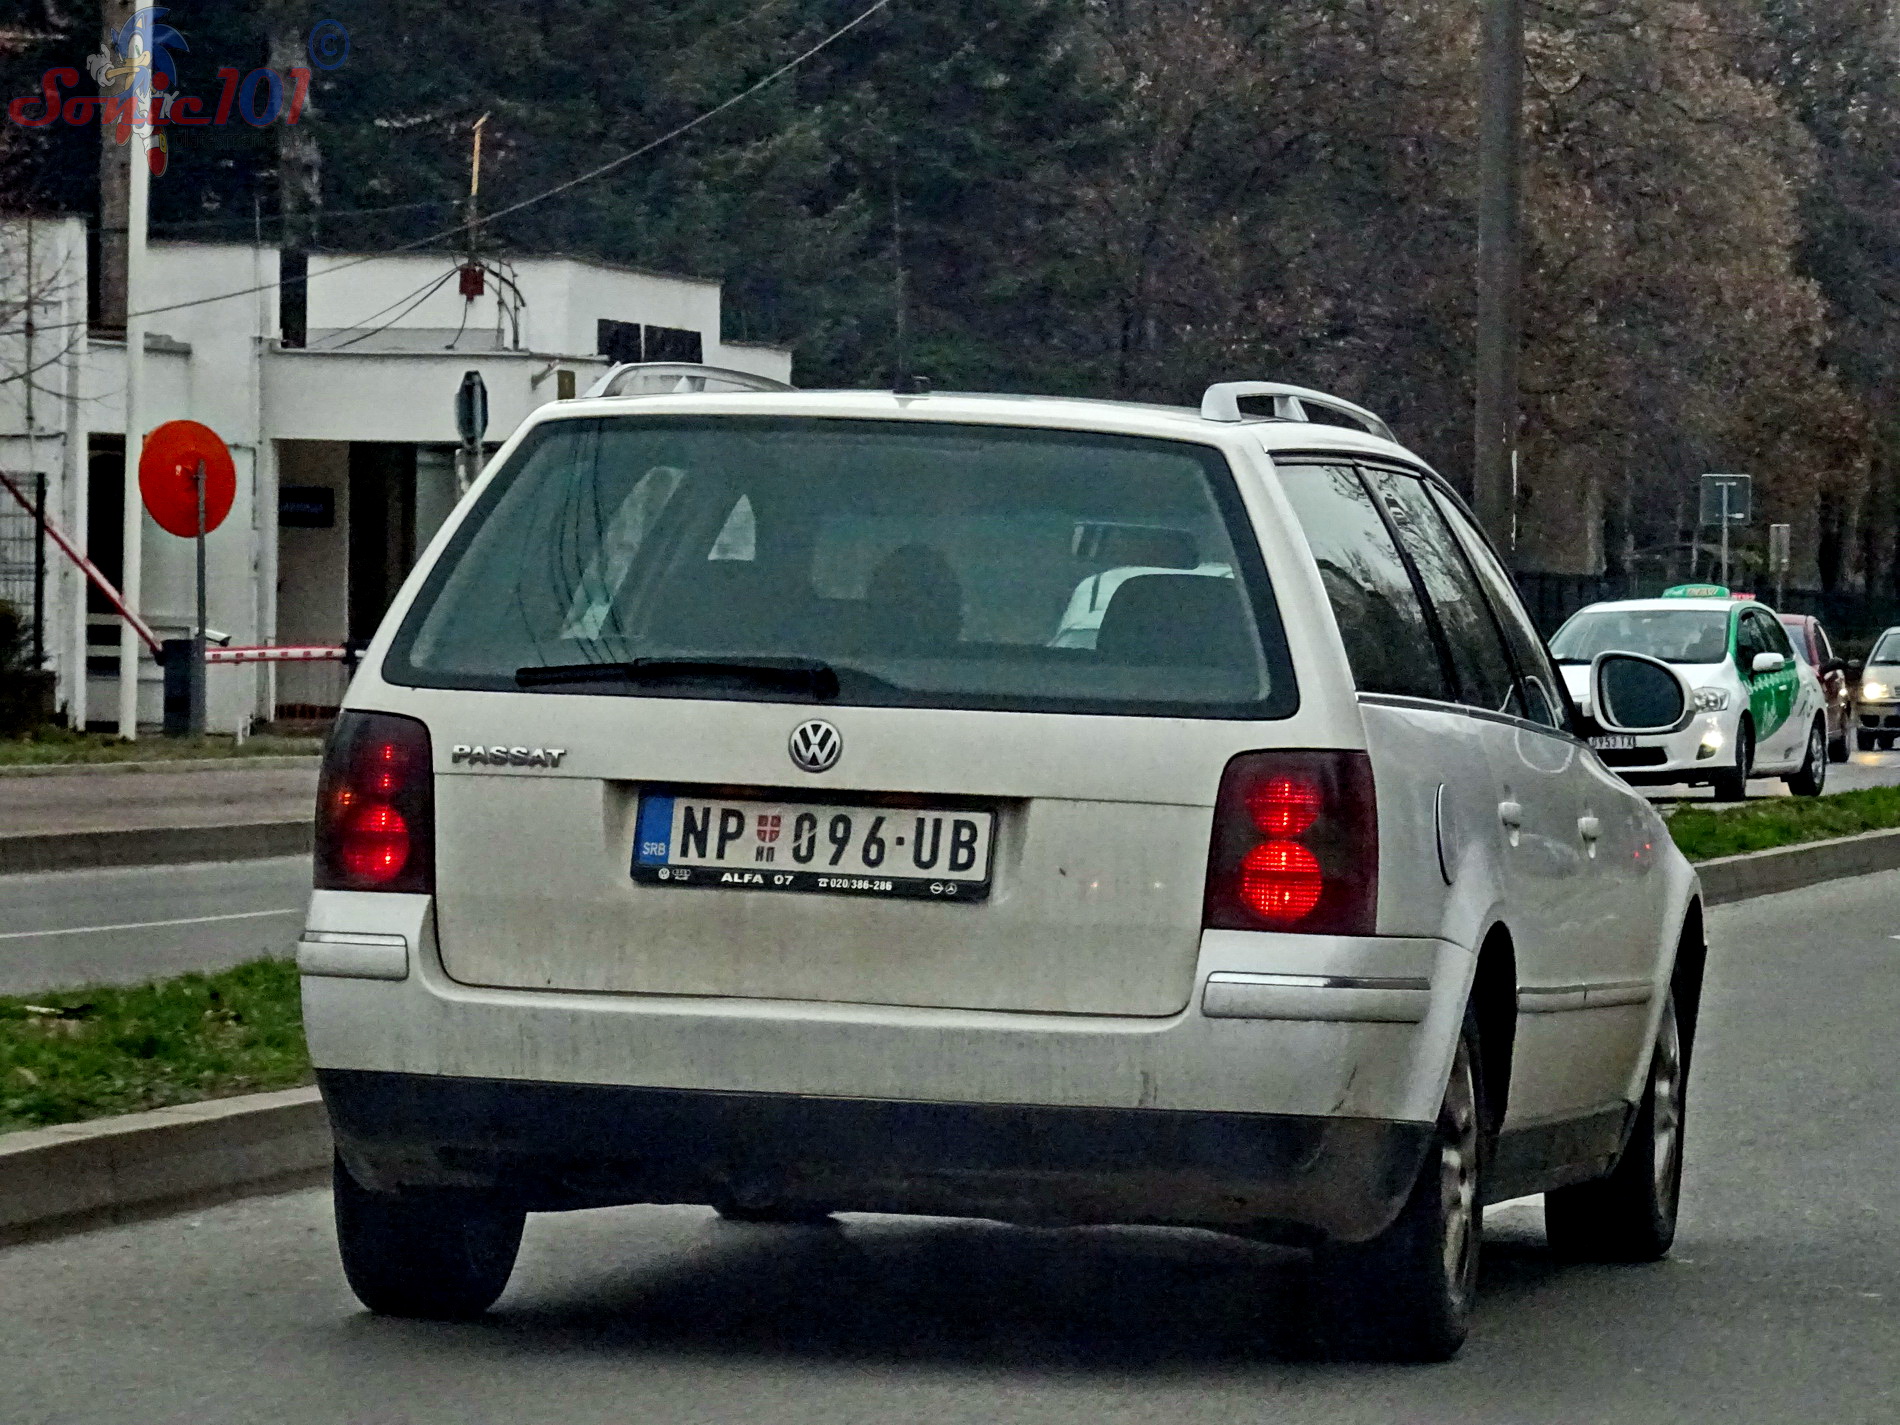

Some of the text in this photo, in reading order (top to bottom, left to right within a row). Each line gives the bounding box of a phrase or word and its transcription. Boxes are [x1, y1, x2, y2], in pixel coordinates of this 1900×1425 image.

[451, 744, 567, 769] PASSAT
[680, 806, 745, 860] NP
[643, 842, 666, 856] SRB
[721, 872, 794, 885] ALFA 07
